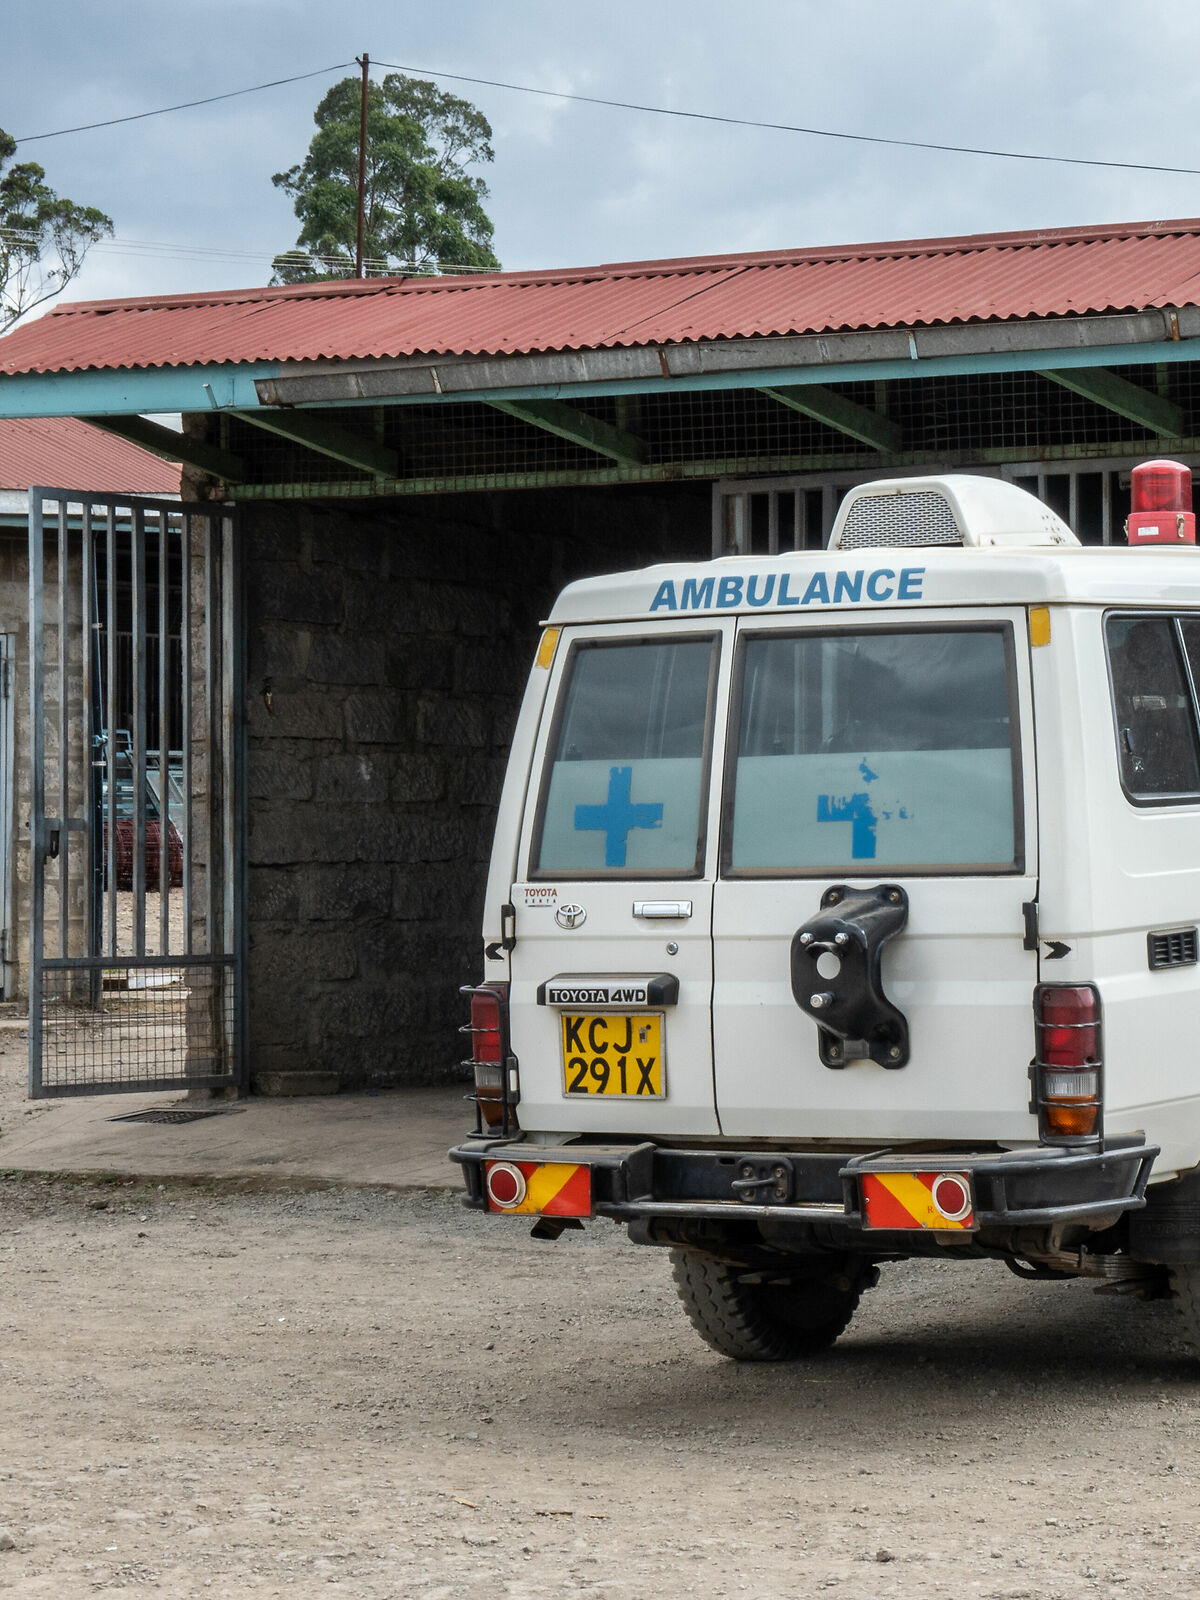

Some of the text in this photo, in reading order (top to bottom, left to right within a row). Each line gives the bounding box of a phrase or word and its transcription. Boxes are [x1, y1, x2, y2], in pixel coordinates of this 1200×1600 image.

[649, 567, 926, 611] AMBULANCE
[525, 888, 558, 897] TOYOTA
[551, 989, 646, 1002] TOYOTA 4WD
[565, 1016, 633, 1055] KCJ
[567, 1056, 656, 1095] 291X
